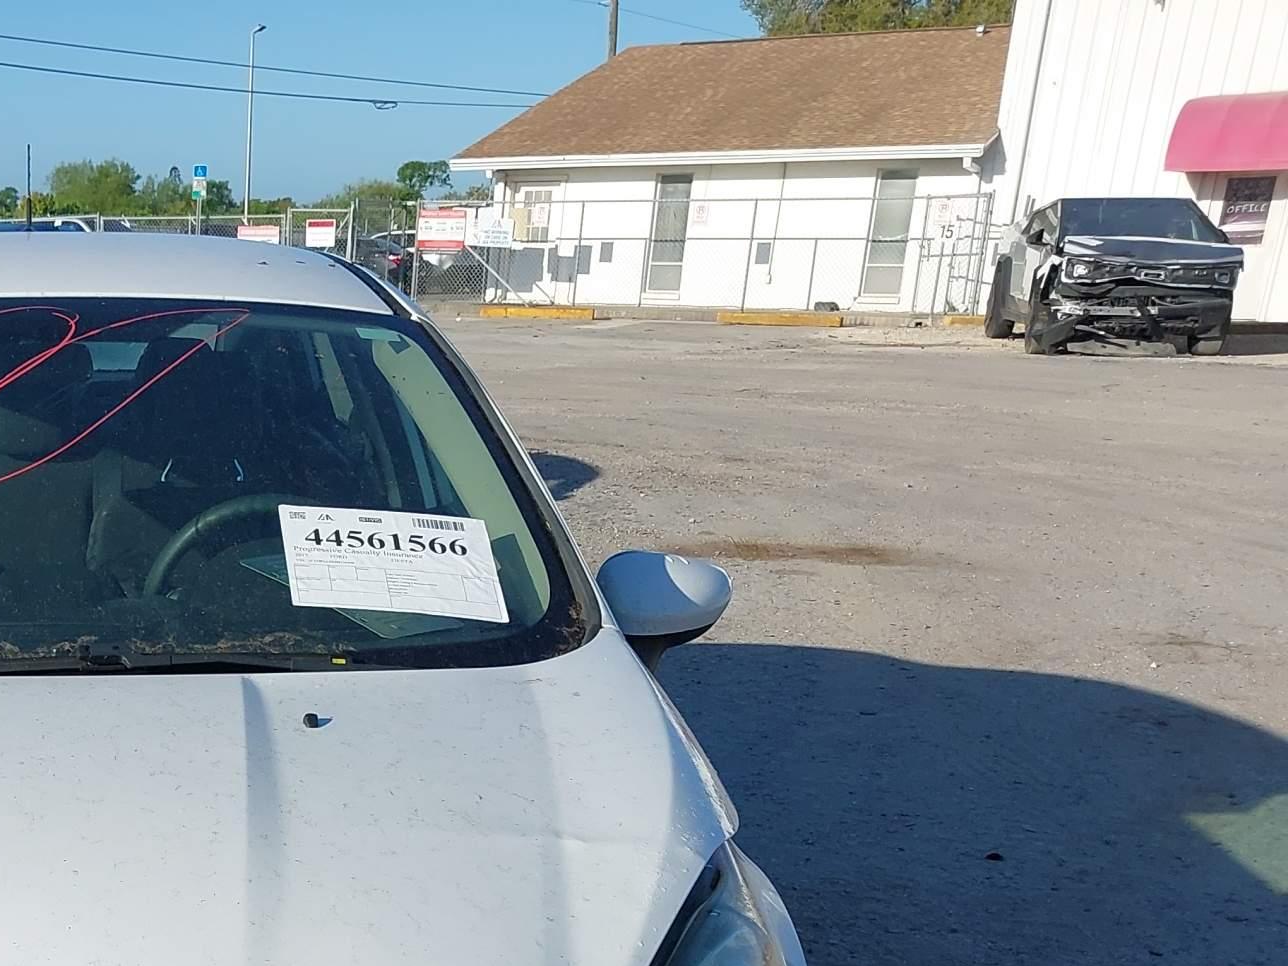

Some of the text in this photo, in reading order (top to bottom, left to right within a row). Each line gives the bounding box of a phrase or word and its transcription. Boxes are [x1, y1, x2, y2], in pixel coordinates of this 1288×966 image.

[940, 224, 955, 239] 15
[304, 527, 468, 556] 44561566
[293, 545, 343, 554] Progressive
[344, 548, 381, 557] Casualty
